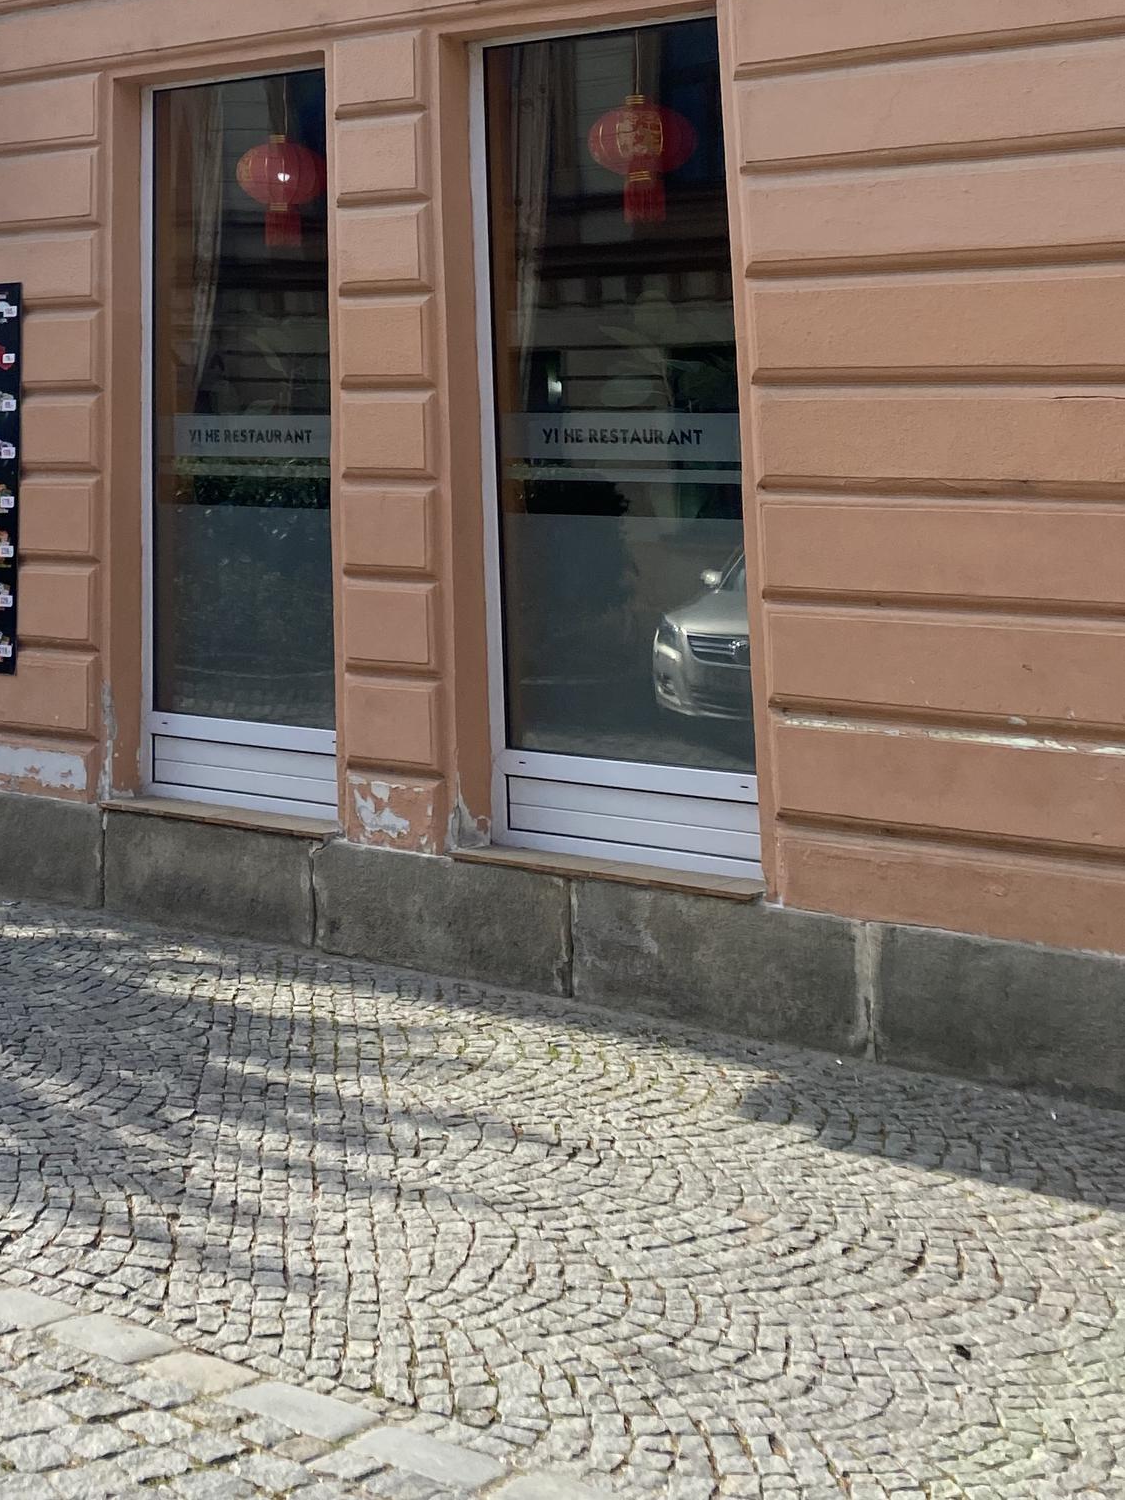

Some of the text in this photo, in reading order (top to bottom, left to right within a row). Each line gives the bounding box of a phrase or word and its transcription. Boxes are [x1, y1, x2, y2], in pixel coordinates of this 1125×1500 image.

[189, 429, 312, 444] YI HE RESTAURANT
[542, 428, 703, 445] YI HE RESTAURANT
